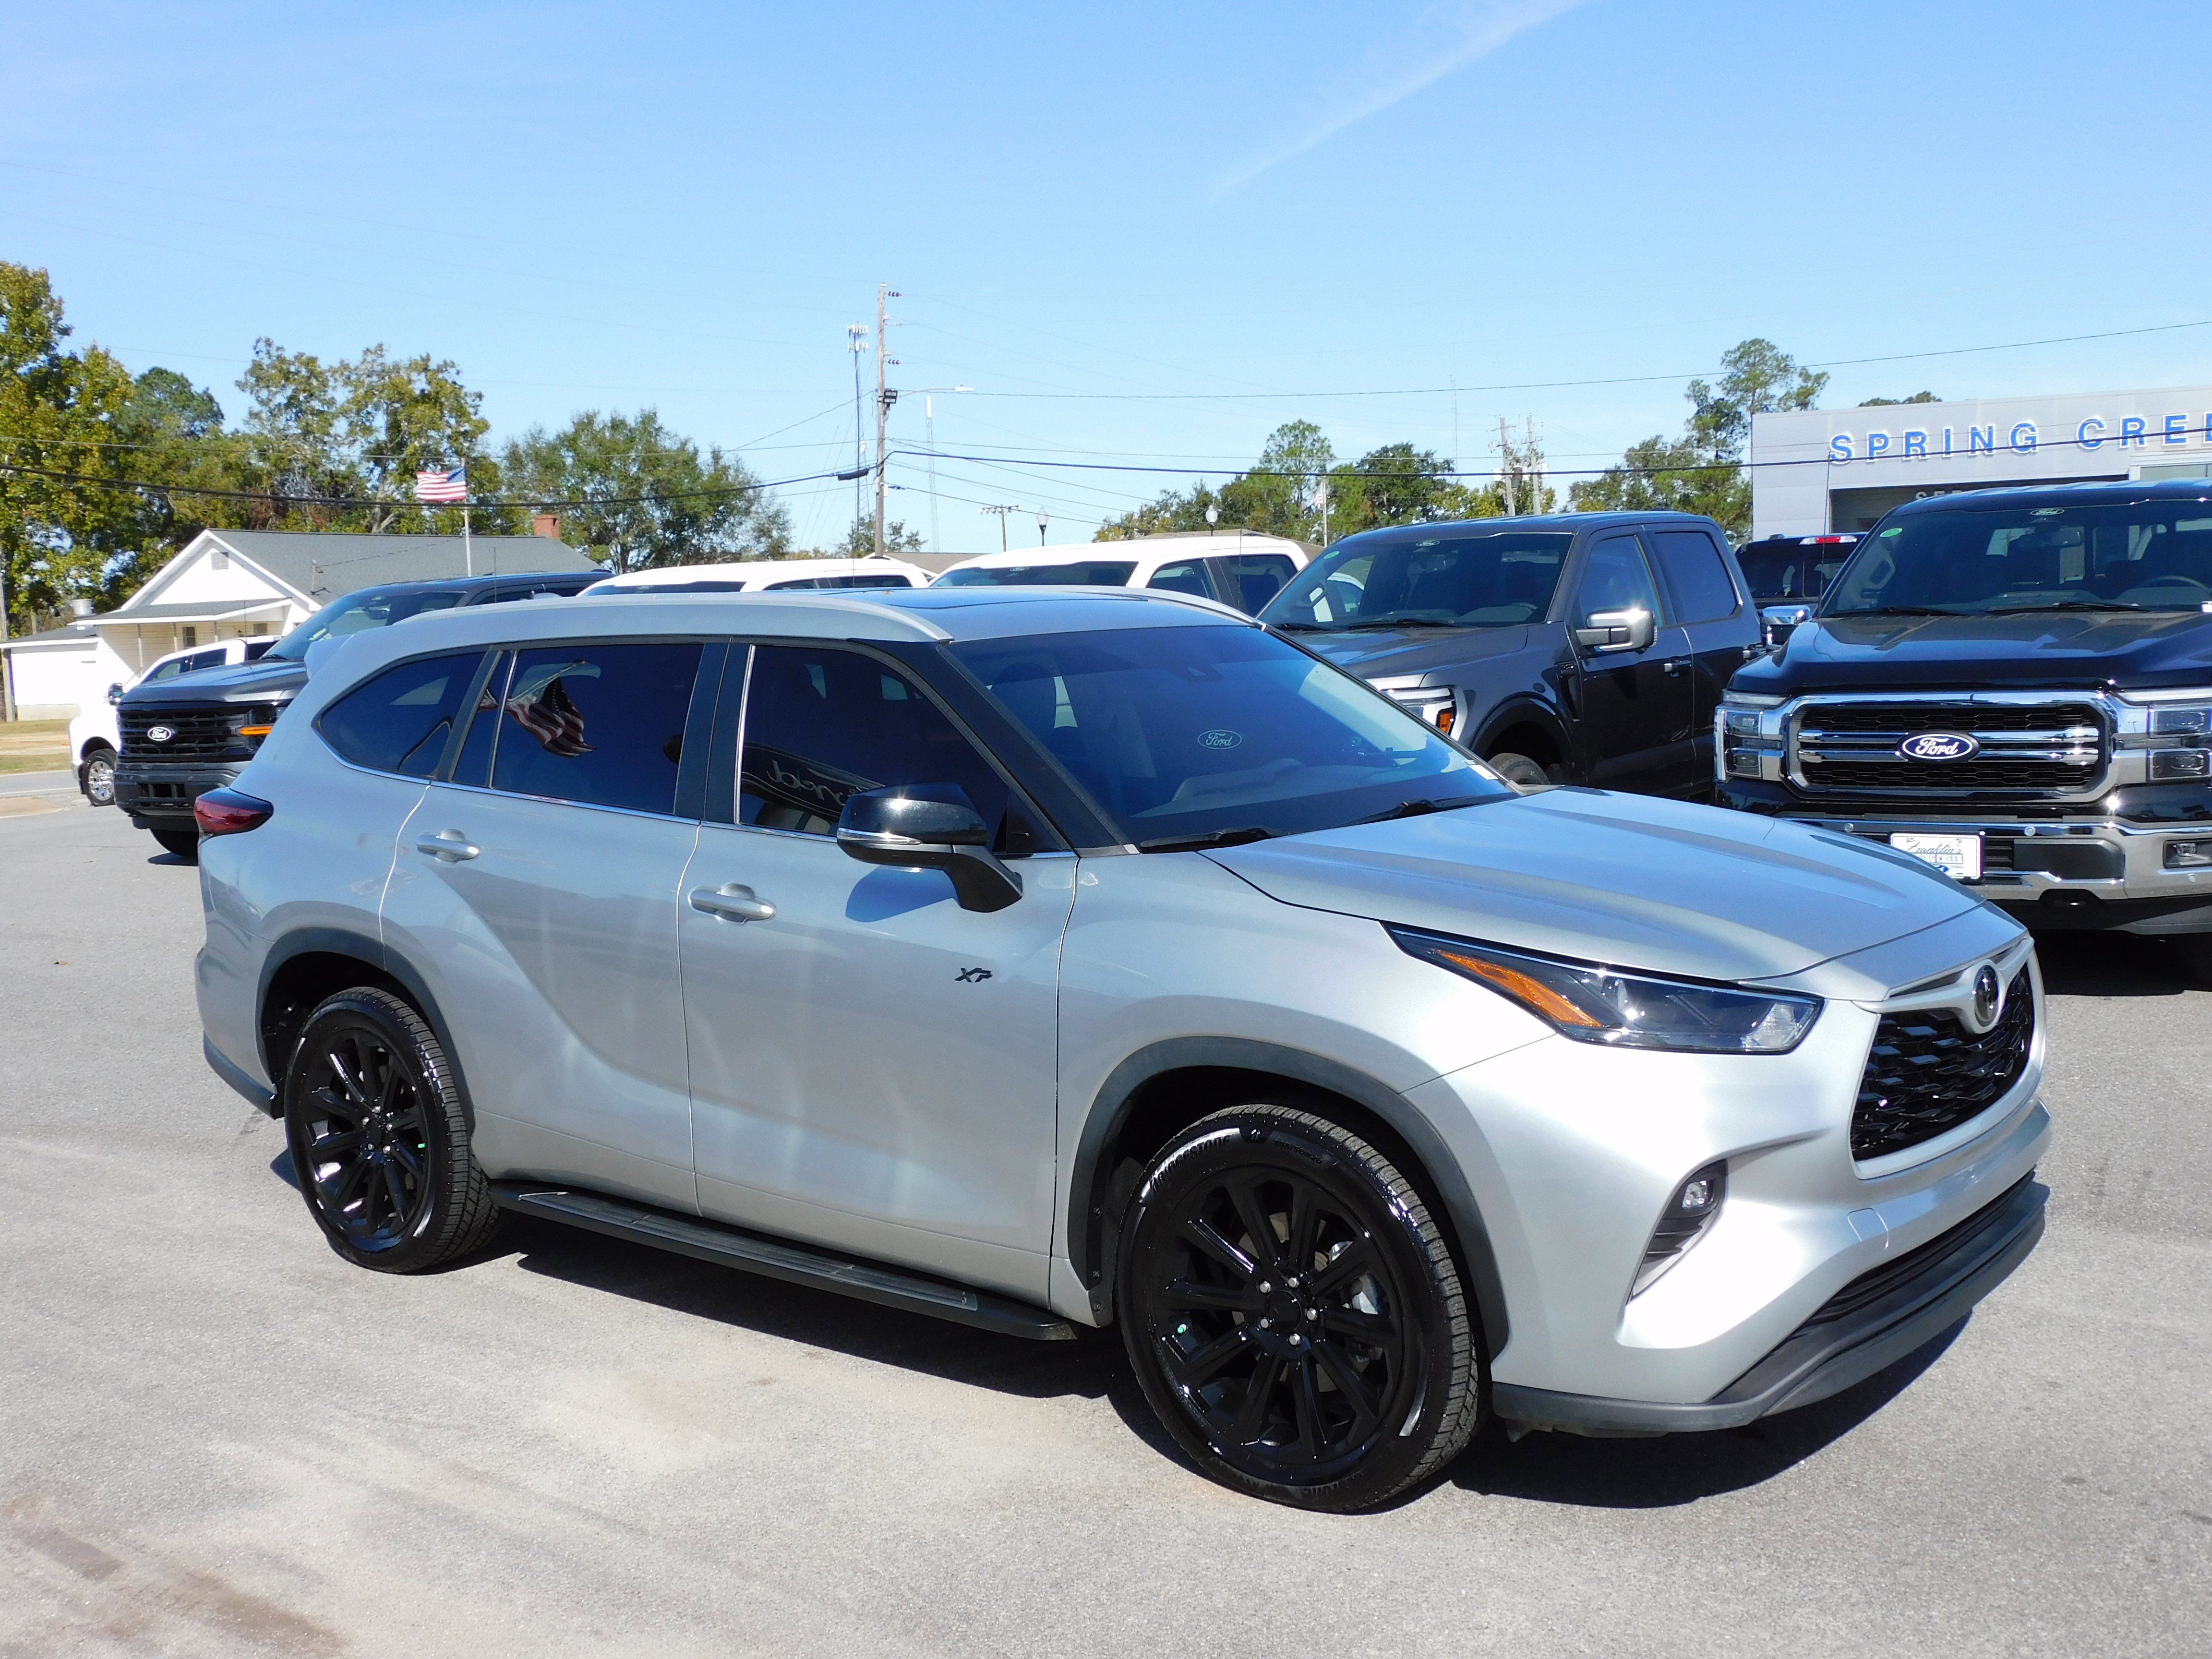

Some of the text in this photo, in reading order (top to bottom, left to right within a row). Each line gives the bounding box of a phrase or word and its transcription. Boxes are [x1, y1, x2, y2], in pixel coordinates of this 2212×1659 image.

[1829, 422, 2040, 464] SPRING
[152, 729, 167, 738] Ford
[1205, 732, 1233, 746] Ford
[1915, 737, 1960, 755] Ford
